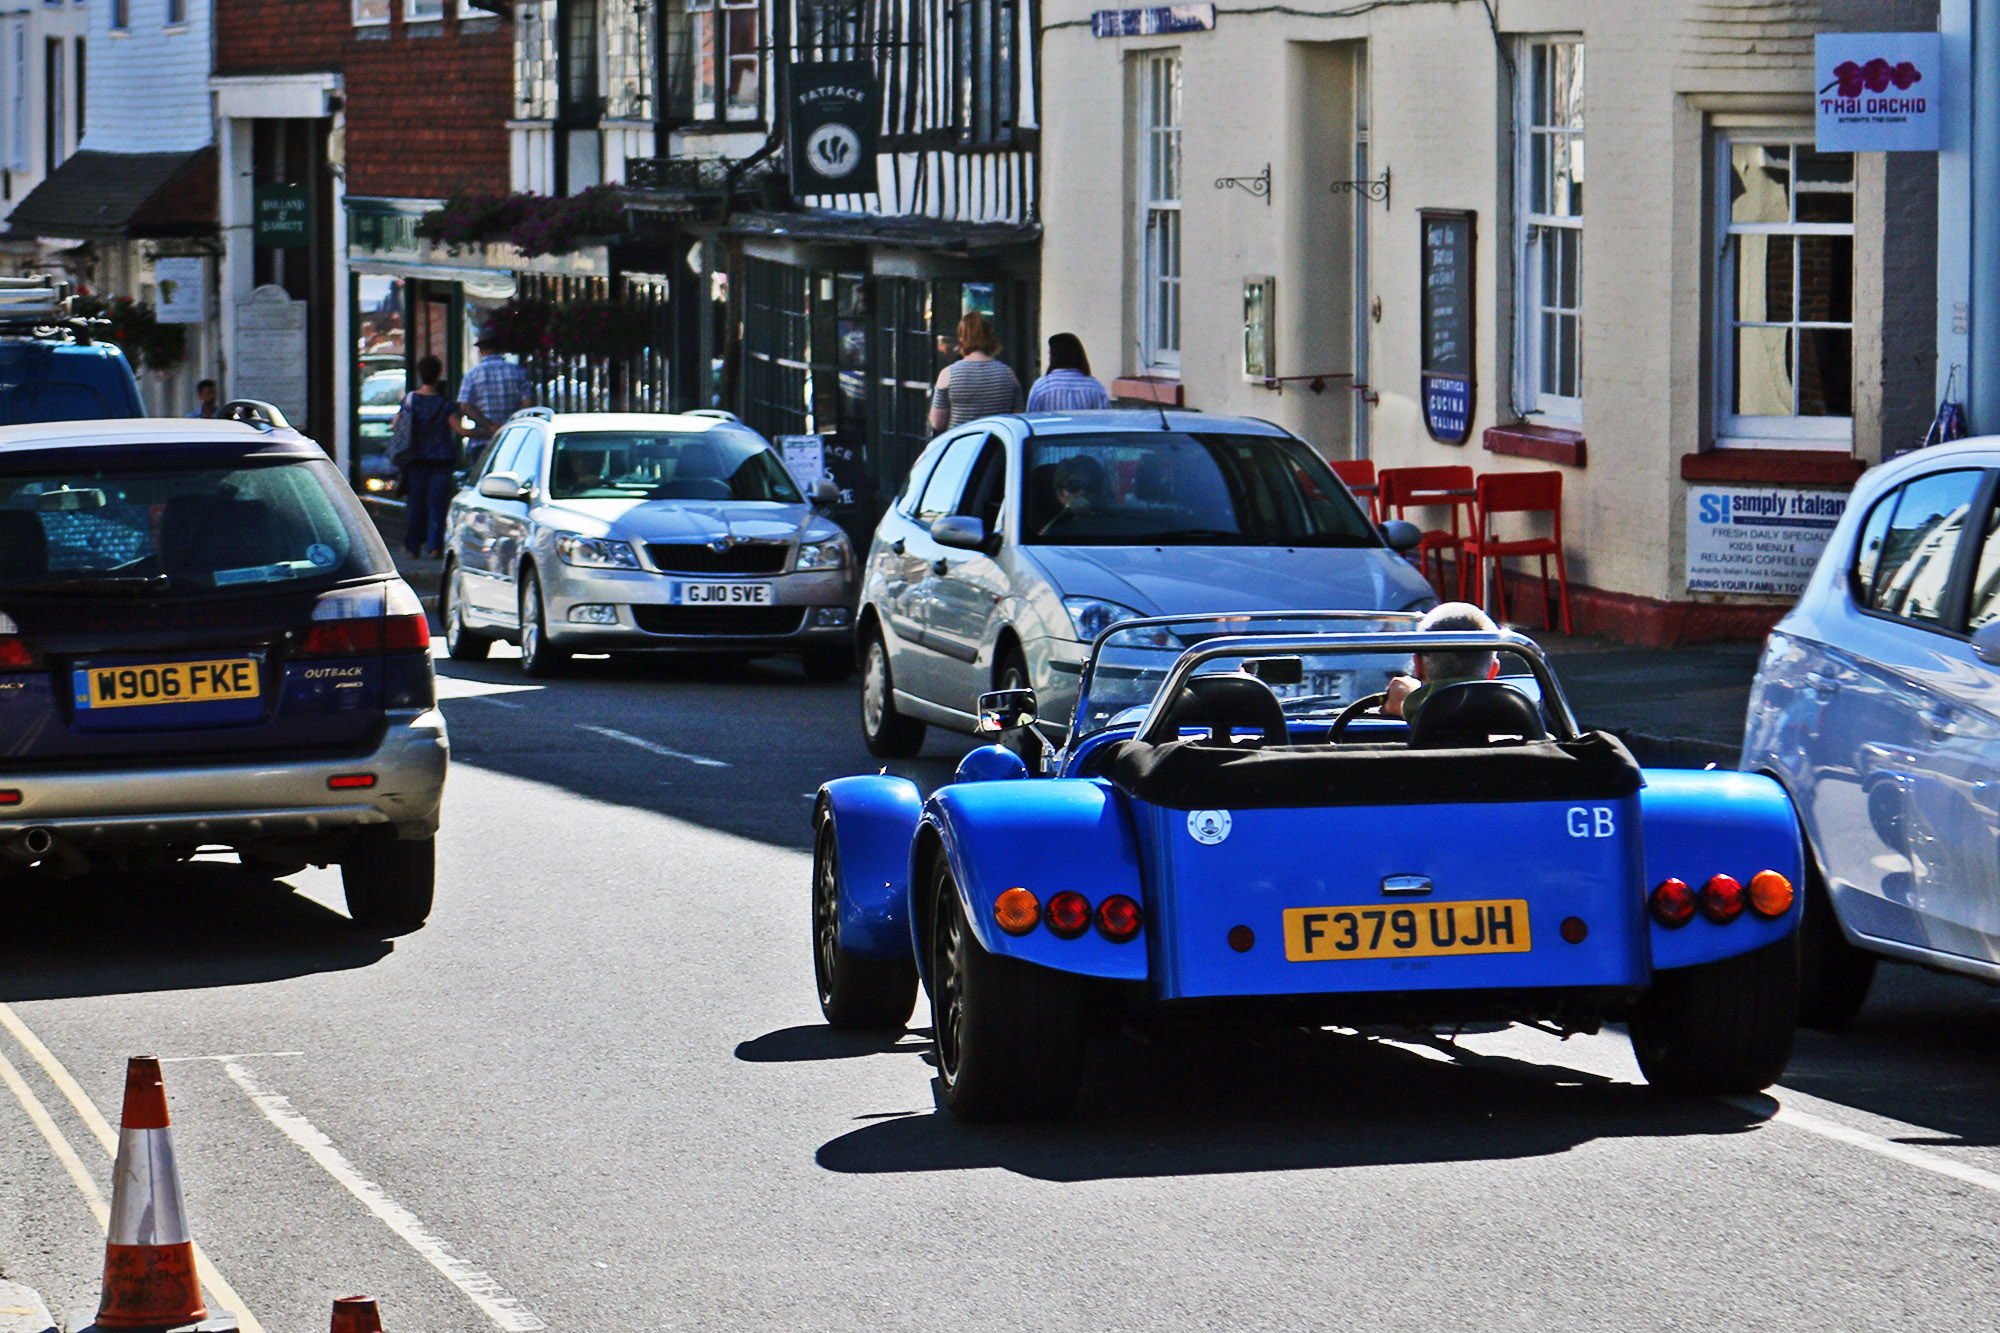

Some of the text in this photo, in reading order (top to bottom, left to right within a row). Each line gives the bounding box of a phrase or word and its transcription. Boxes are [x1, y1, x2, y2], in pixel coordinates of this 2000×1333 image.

[799, 85, 865, 104] FATFACE
[1866, 98, 1926, 114] ORCHID
[1430, 395, 1464, 413] CUCINA
[1431, 416, 1464, 431] ITALIANA
[1712, 528, 1748, 538] FRESH
[1750, 529, 1779, 540] DAILY
[1729, 542, 1753, 551] KIDS
[1756, 543, 1788, 553] MENU
[1701, 552, 1753, 564] RELAXING
[1755, 554, 1798, 566] COFFEE
[688, 585, 765, 602] GJ10 SVE
[1689, 579, 1719, 589] BRING
[1720, 580, 1748, 590] YOUR
[1748, 581, 1783, 593] FAMILY
[1784, 583, 1798, 593] TO
[304, 667, 363, 679] OUTBACK
[97, 663, 252, 701] W906 FKE
[1567, 807, 1615, 838] GB
[1303, 905, 1515, 954] F379 UJH
